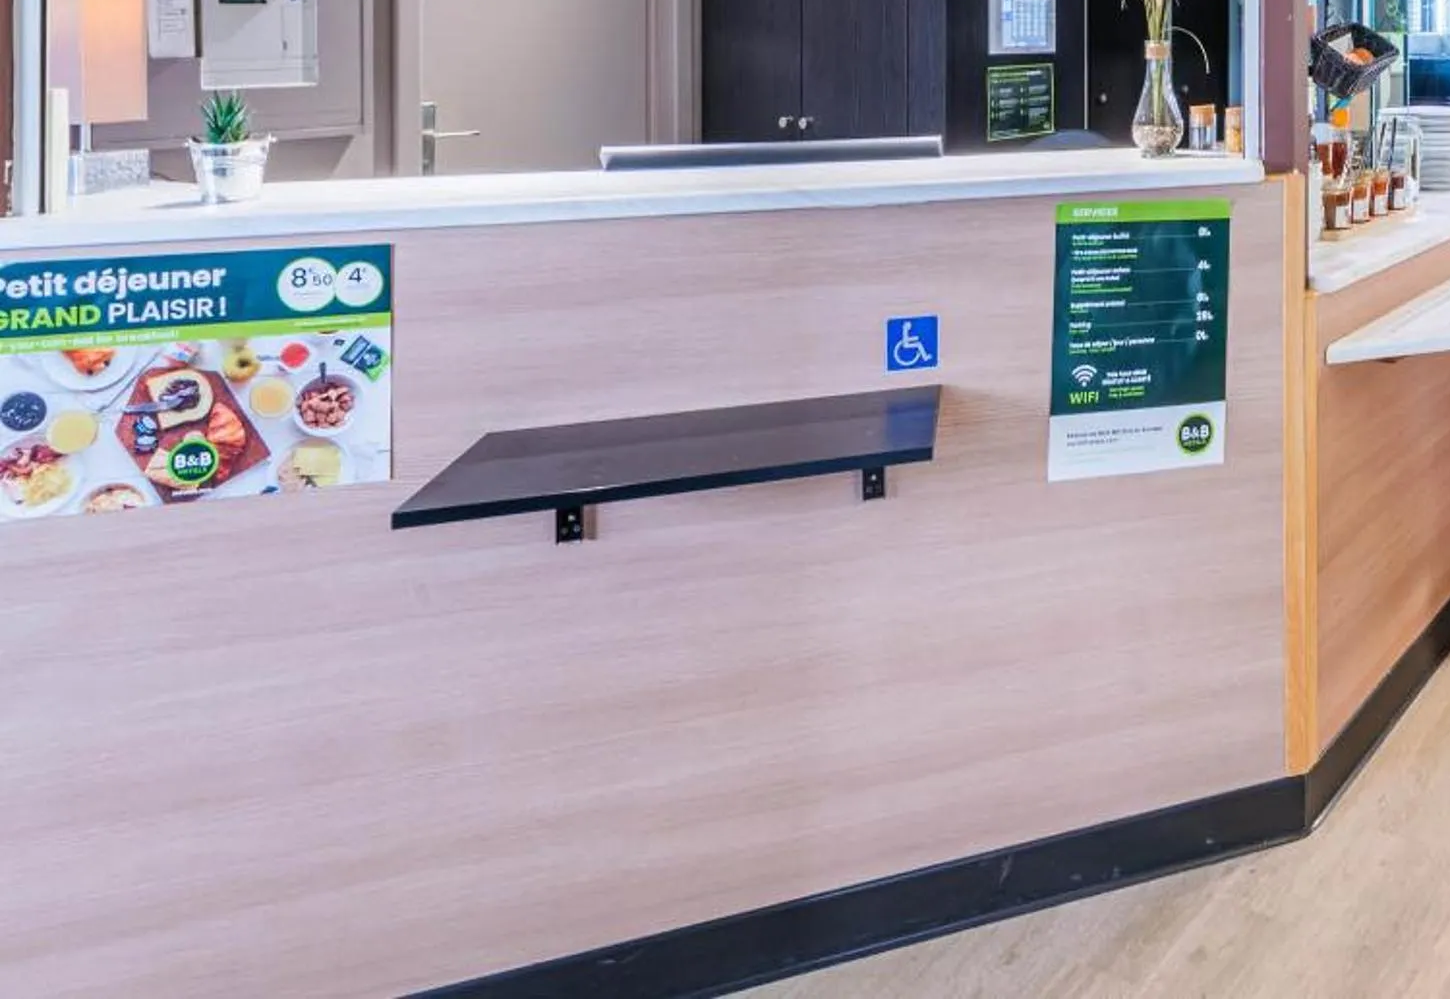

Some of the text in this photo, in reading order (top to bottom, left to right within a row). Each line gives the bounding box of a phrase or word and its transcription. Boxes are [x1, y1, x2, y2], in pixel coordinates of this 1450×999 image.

[73, 267, 227, 300] déjeuner
[107, 298, 214, 325] PLAISIR
[1069, 390, 1100, 405] WIFI
[1181, 424, 1209, 441] B&B
[174, 450, 213, 469] B&B
